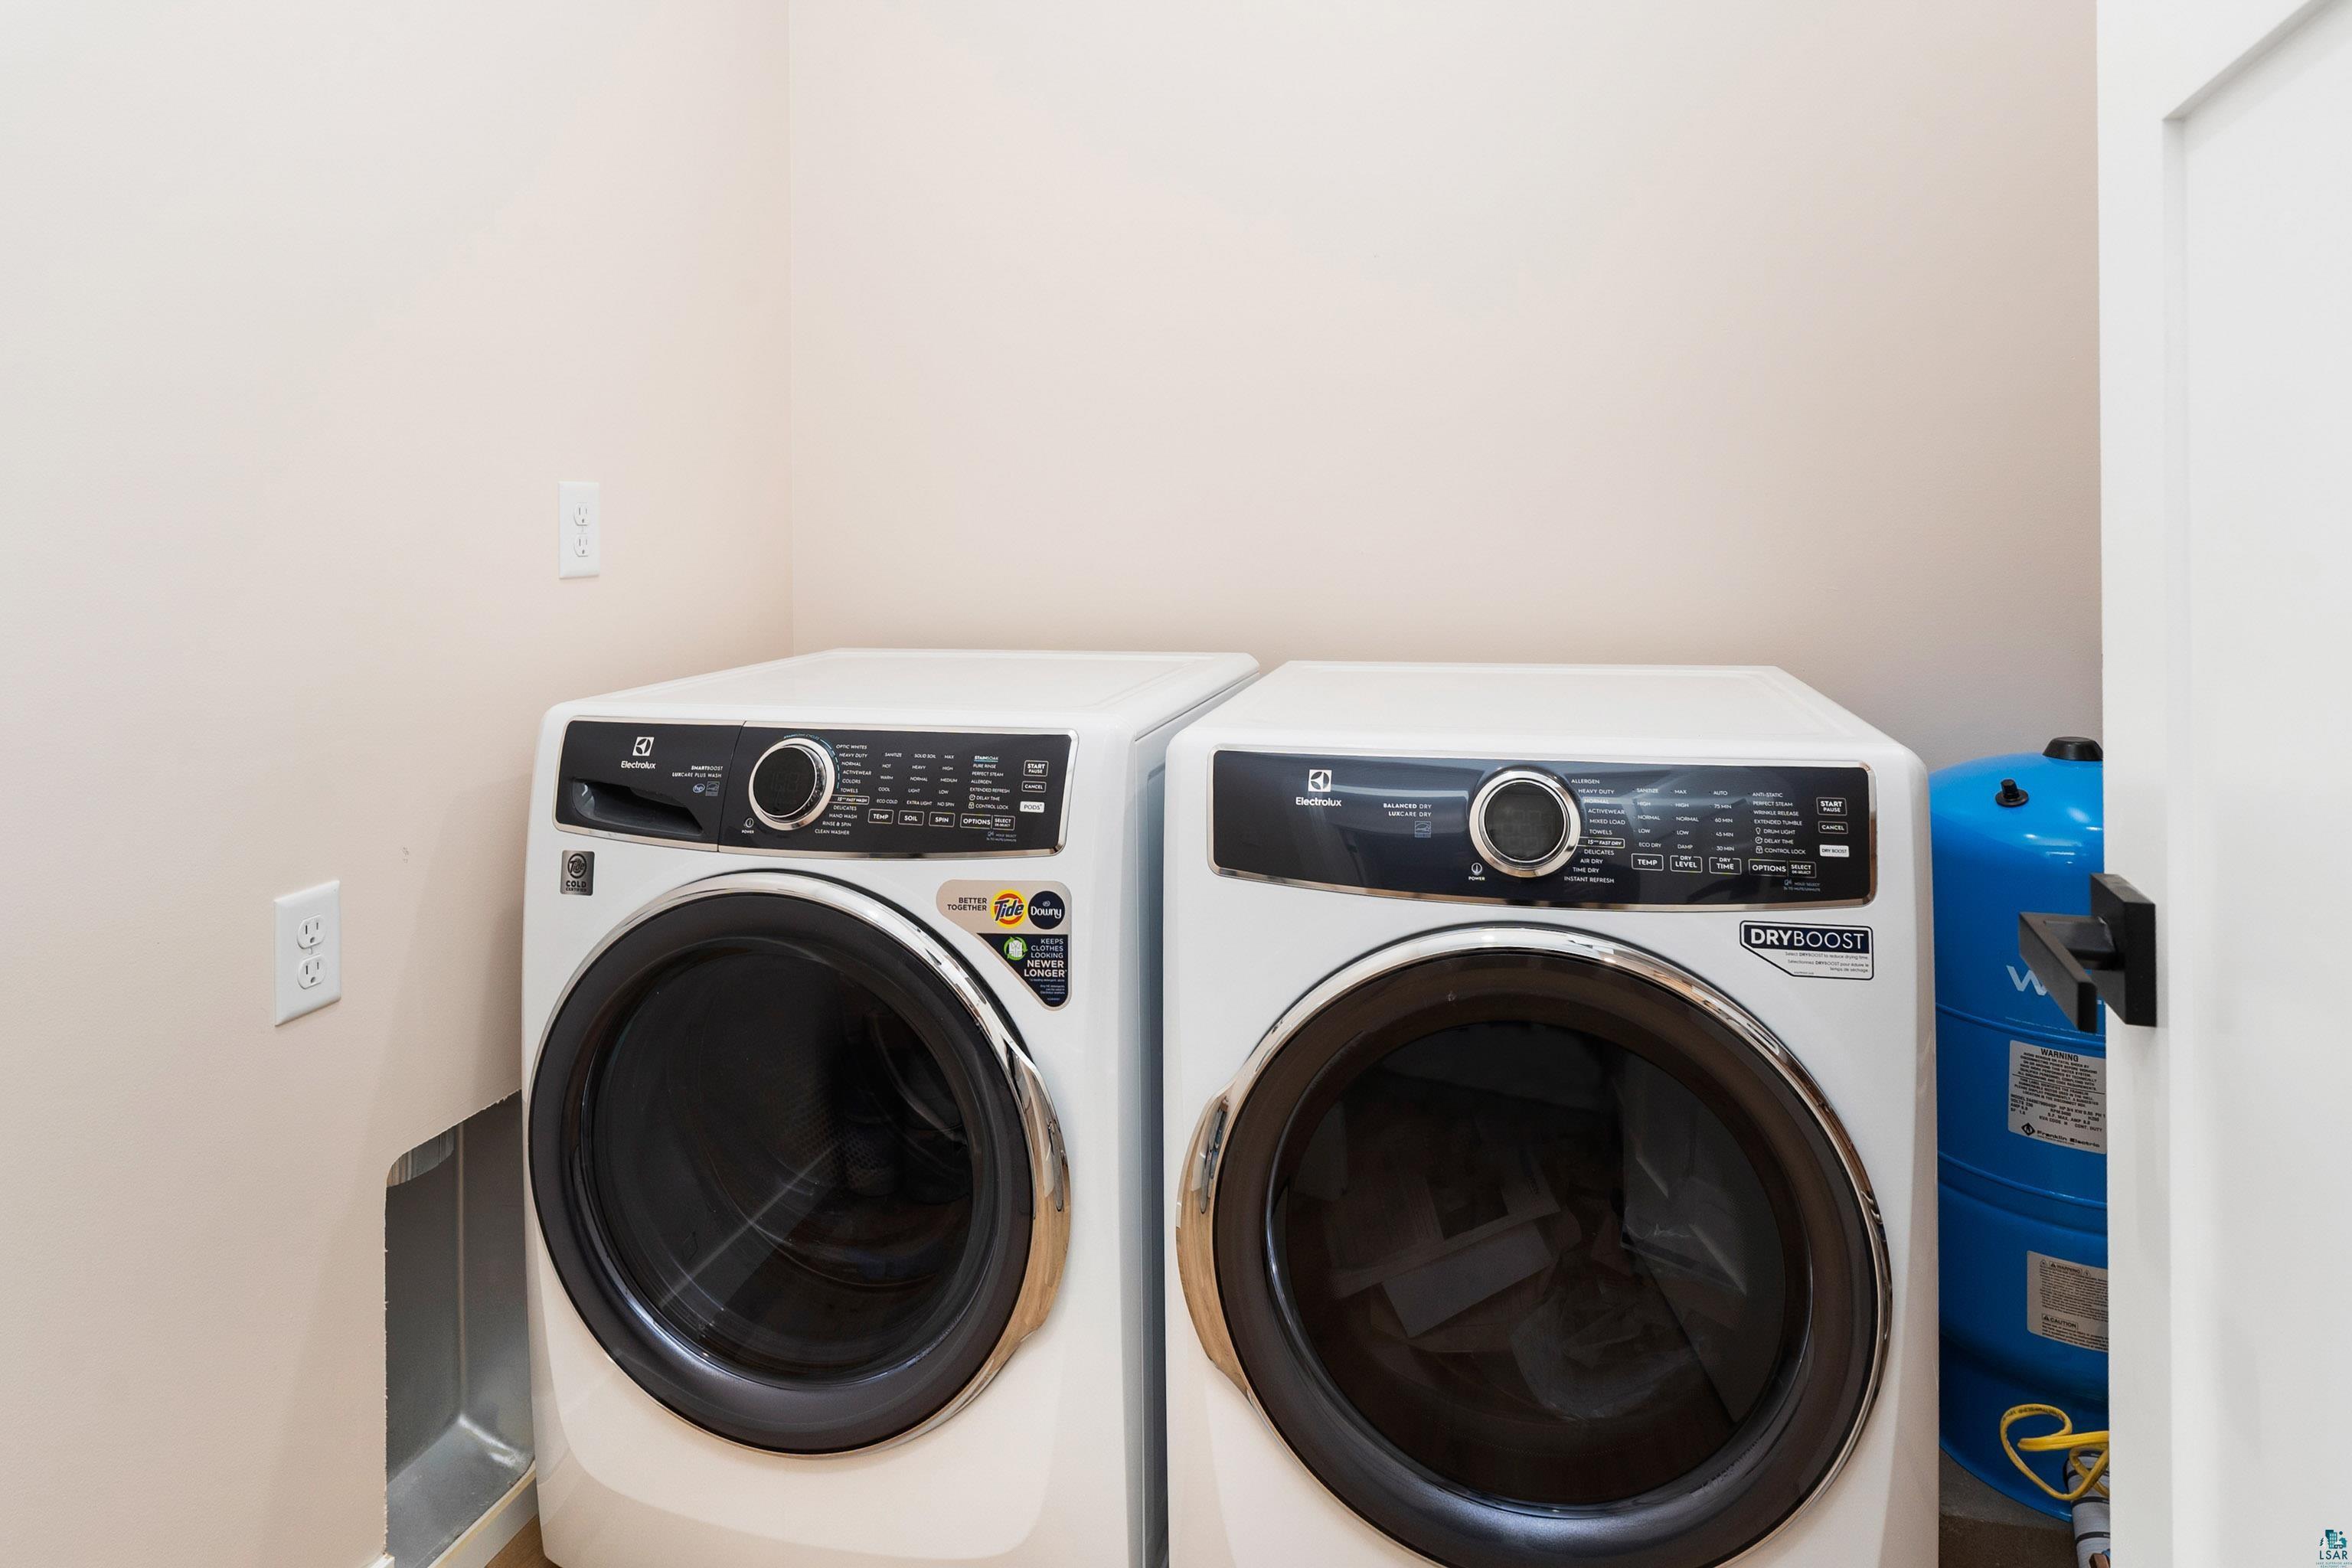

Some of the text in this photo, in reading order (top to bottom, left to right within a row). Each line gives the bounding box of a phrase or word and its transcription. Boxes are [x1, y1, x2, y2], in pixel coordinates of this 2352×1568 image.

[621, 760, 656, 769] Electrolux
[1295, 796, 1341, 806] Electrolux
[570, 858, 585, 874] Tide
[994, 898, 1024, 922] Tide
[1031, 906, 1062, 919] Downy
[1750, 929, 1864, 949] DRYBOOST
[1027, 960, 1064, 969] NEWER
[2040, 1048, 2079, 1061] WARNING
[2037, 1130, 2067, 1141] Franklin
[2069, 1138, 2100, 1148] Electric
[2050, 1317, 2076, 1328] CAUTION
